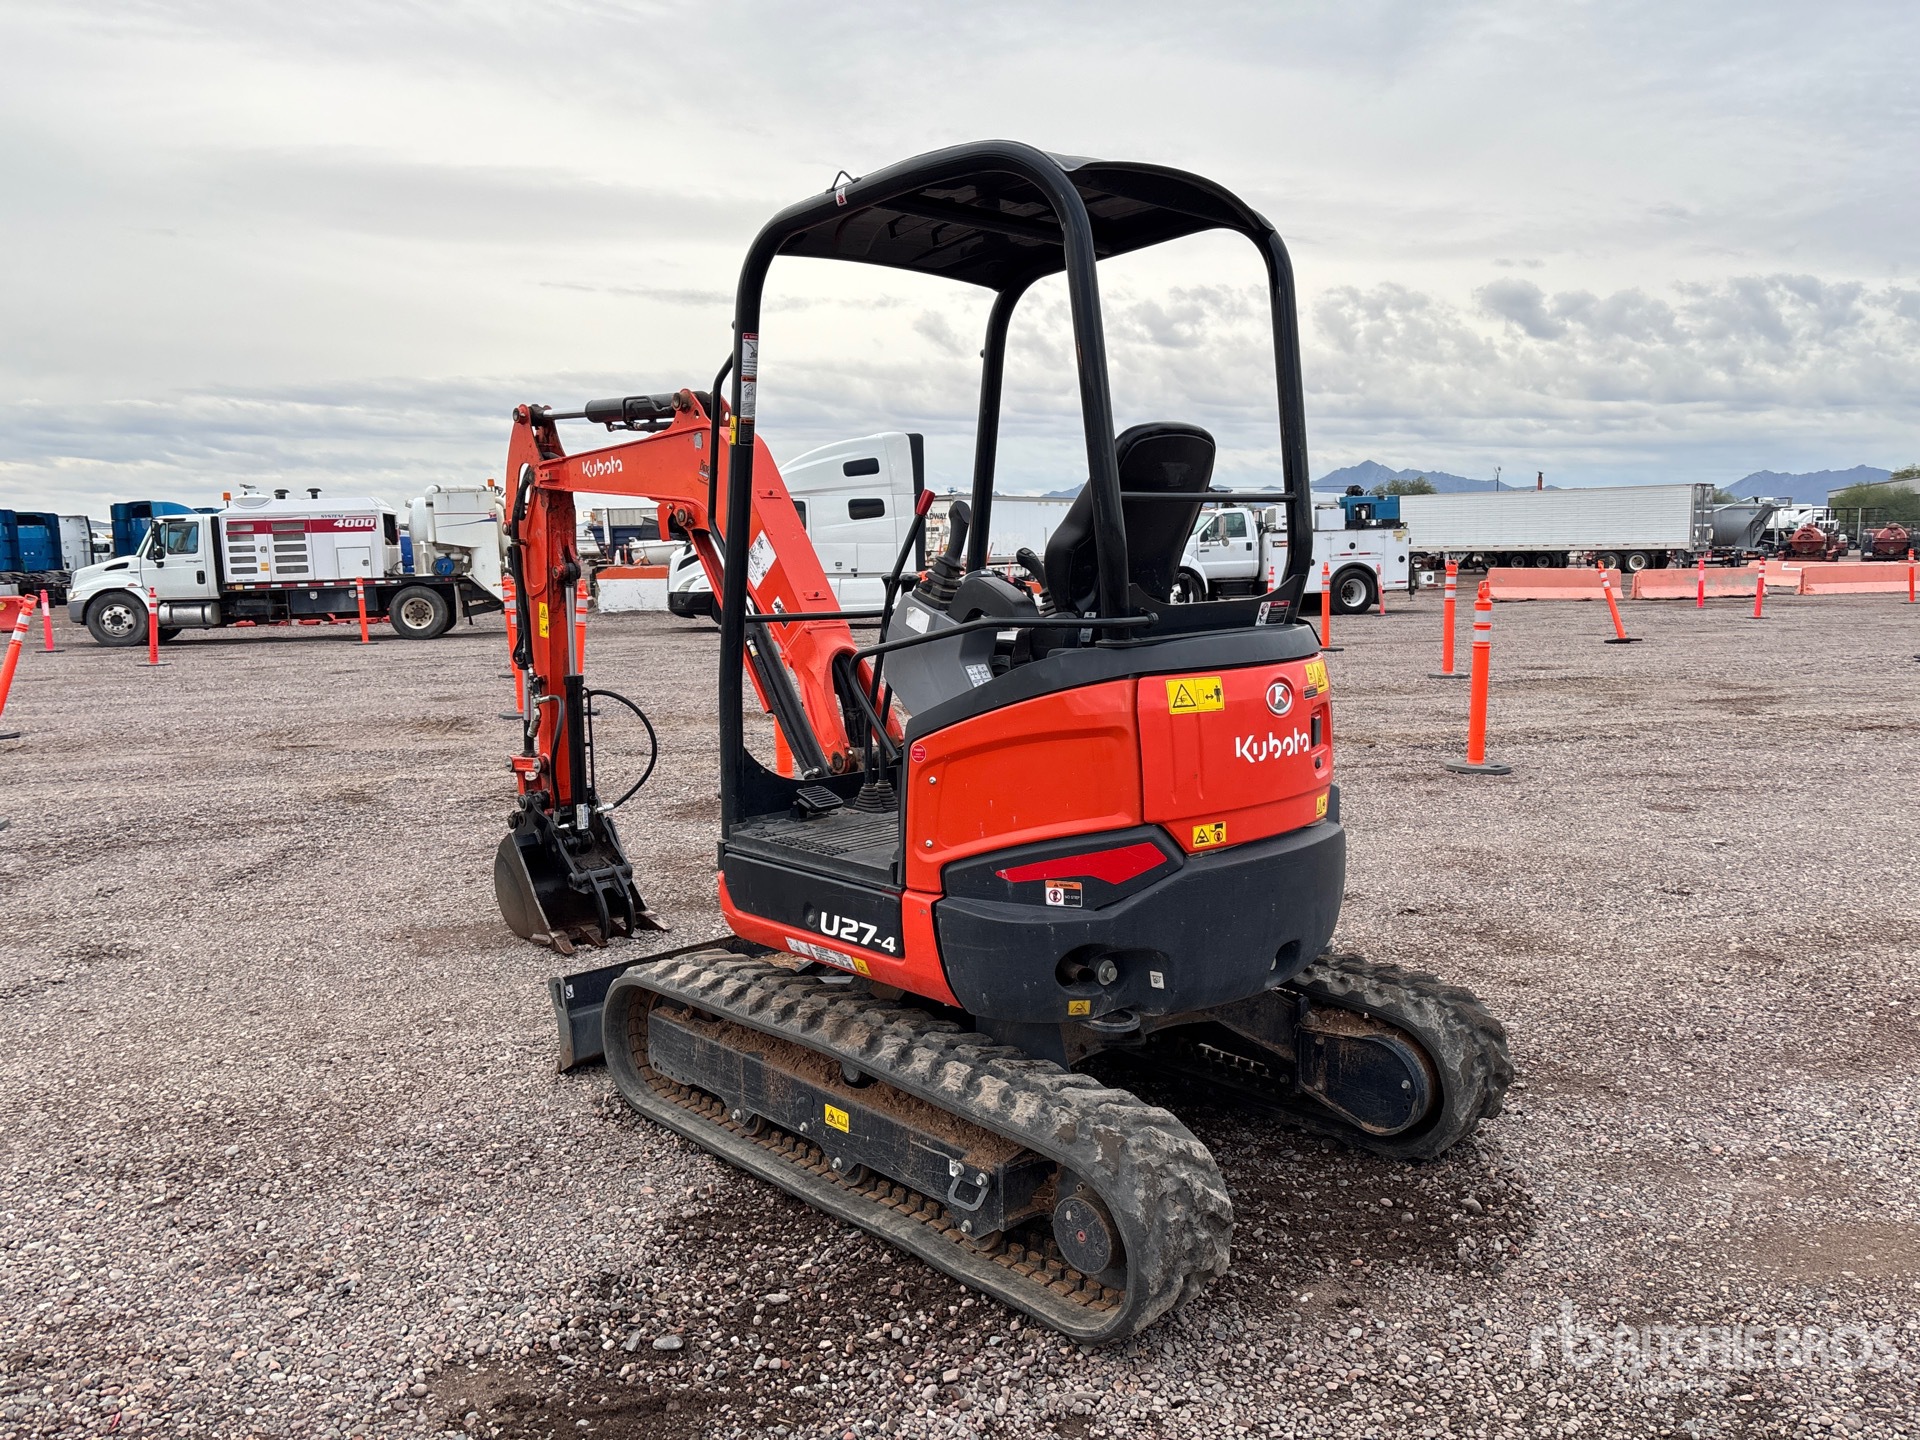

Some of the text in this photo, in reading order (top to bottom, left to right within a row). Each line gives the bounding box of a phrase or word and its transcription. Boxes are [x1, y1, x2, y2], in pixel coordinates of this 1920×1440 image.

[582, 456, 623, 478] Kubota
[333, 518, 375, 528] 4000
[1235, 727, 1310, 763] Kubota
[820, 911, 896, 953] U27-4
